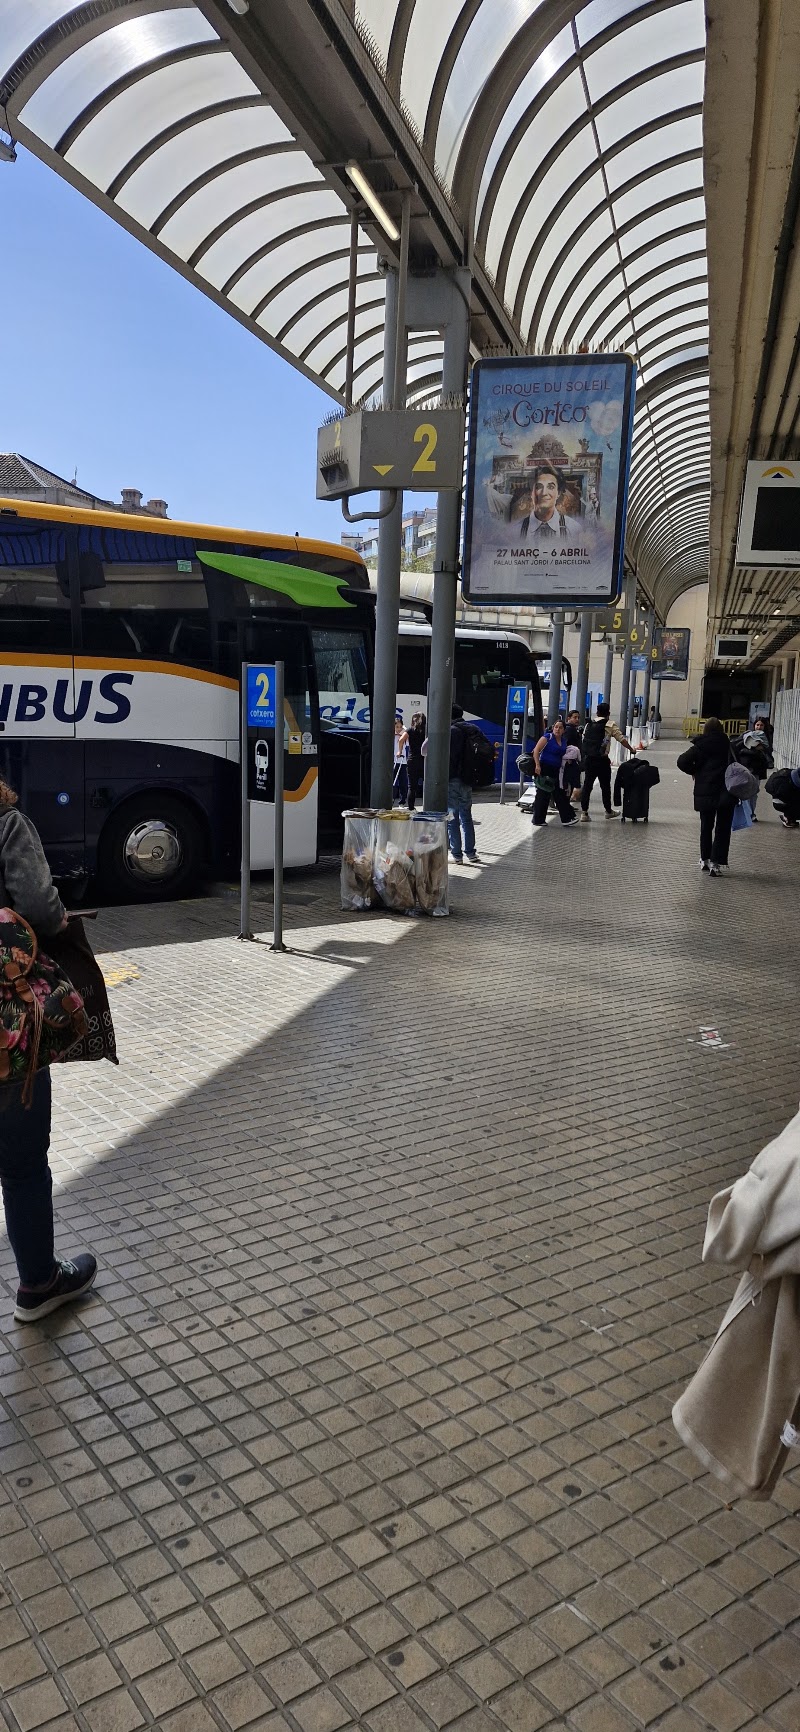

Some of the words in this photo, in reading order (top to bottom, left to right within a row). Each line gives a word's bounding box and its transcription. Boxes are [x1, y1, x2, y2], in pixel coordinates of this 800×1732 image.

[492, 382, 540, 397] CIRQUE
[544, 381, 562, 393] DU
[566, 379, 611, 392] SOLEIL
[512, 400, 590, 428] Corteo
[334, 422, 341, 447] 2
[412, 423, 438, 472] 2
[496, 549, 508, 558] 27
[510, 548, 540, 559] MARÇ
[550, 549, 557, 557] 6
[560, 548, 589, 557] ABRIL
[612, 612, 622, 629] 5
[630, 627, 638, 641] 6
[651, 648, 658, 658] 8
[255, 672, 270, 707] 2
[513, 690, 521, 704] 4
[249, 708, 274, 718] cotxera
